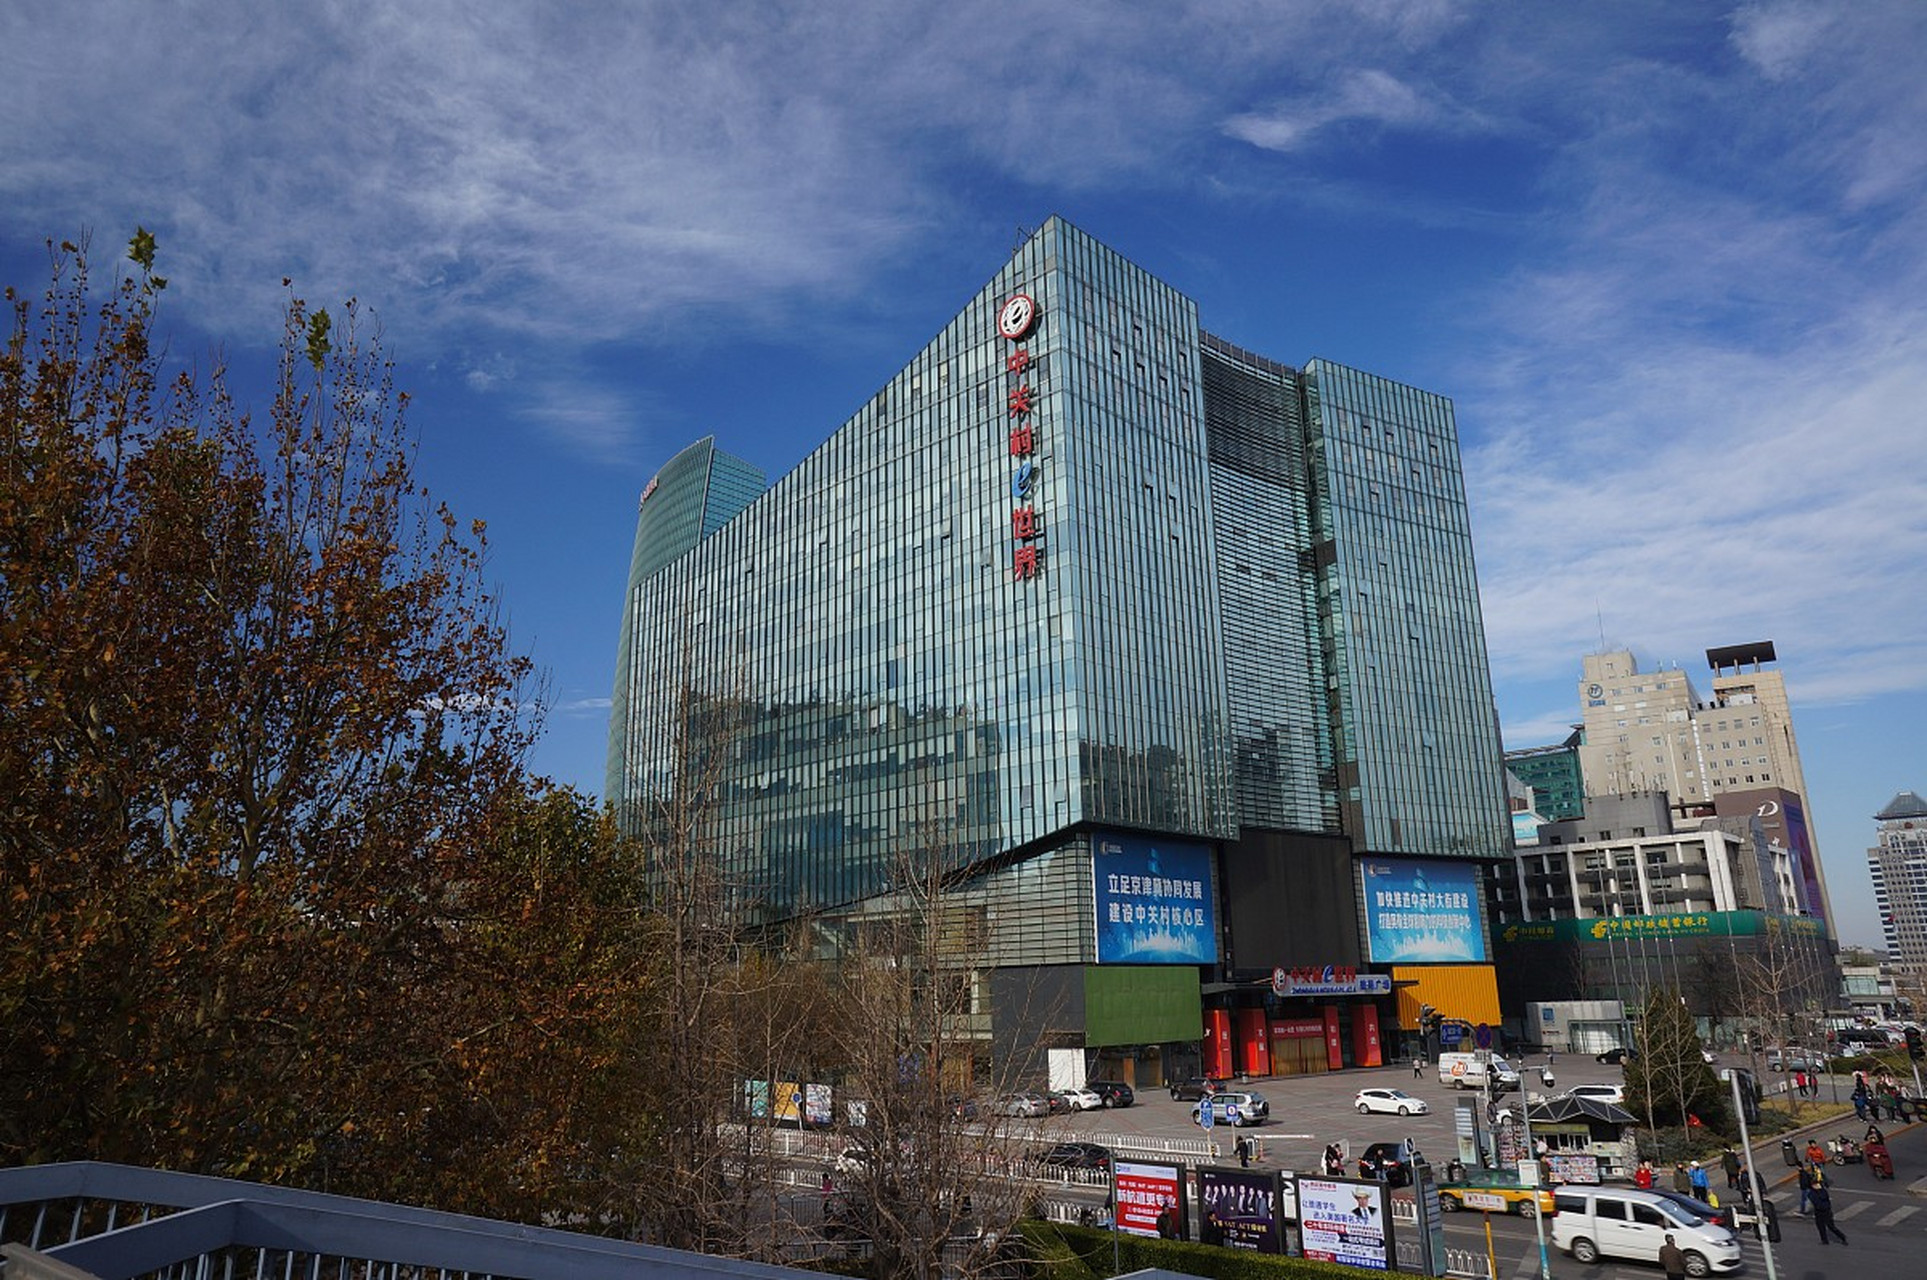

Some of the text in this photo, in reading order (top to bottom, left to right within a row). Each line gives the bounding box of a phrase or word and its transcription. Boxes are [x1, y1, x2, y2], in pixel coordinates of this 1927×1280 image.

[1007, 347, 1036, 581] 中关村e世界
